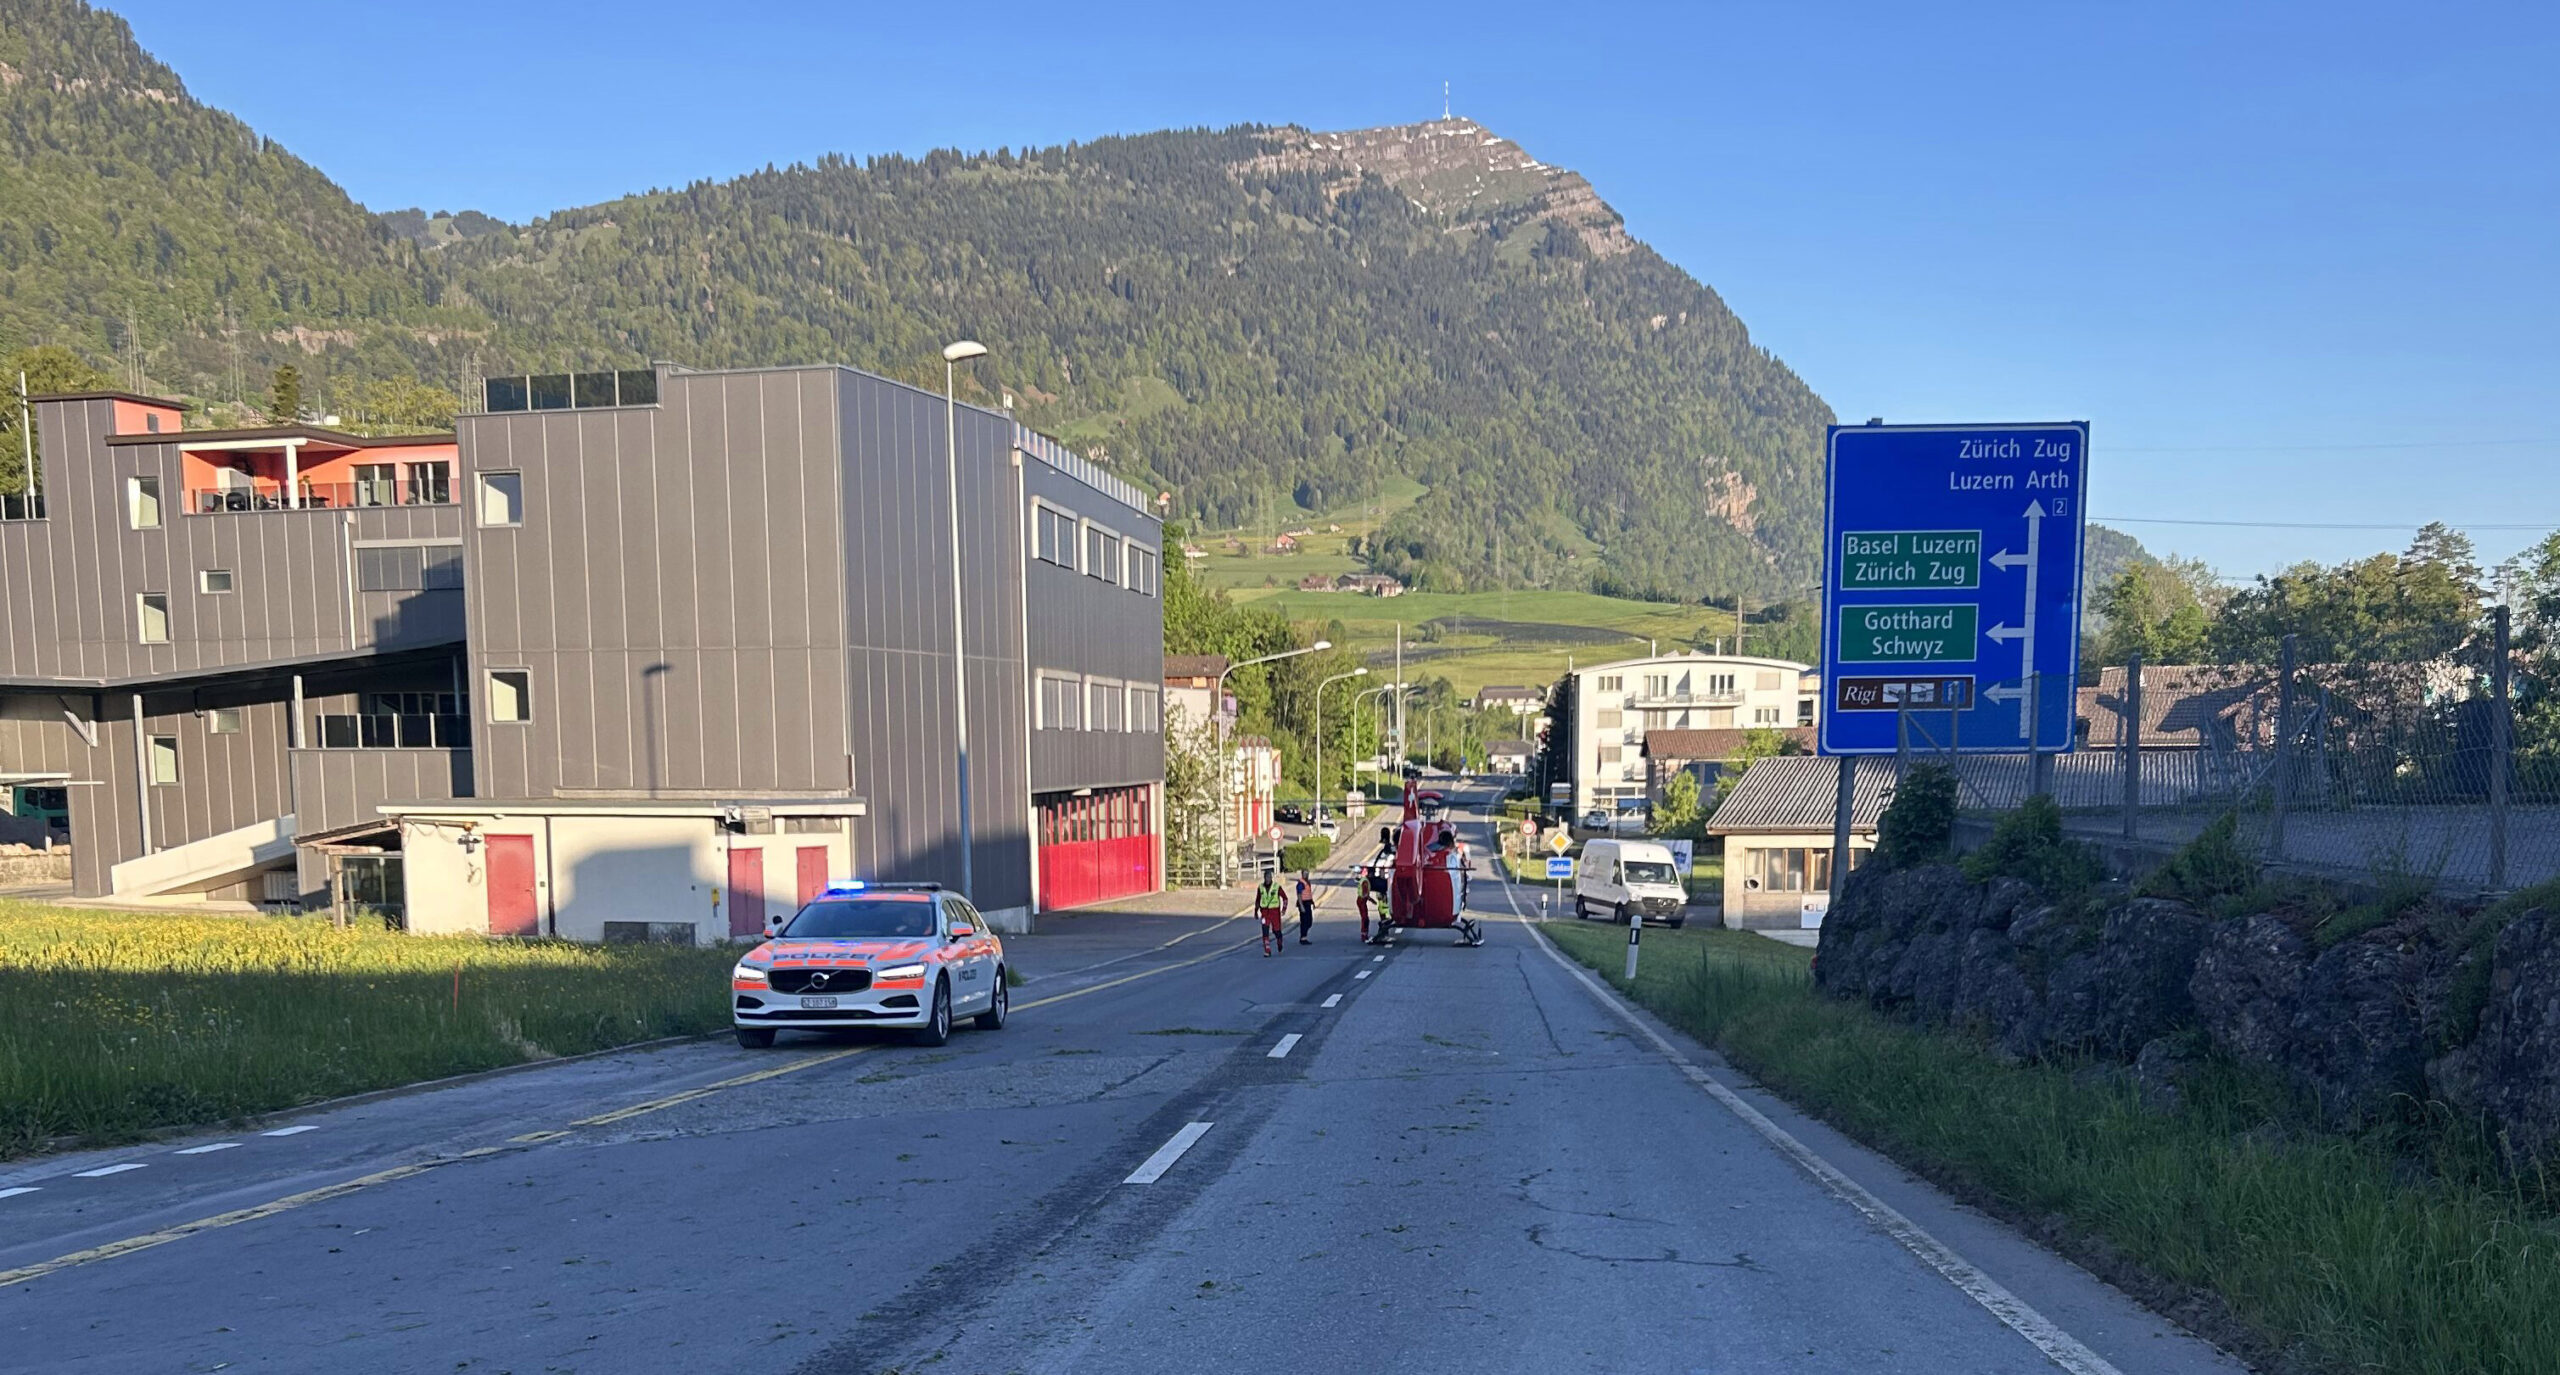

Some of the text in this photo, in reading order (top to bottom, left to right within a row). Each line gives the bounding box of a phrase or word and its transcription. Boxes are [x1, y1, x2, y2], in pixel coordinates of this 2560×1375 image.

[1959, 439, 2071, 462] Zürich Zug
[1950, 470, 2069, 490] Luzern Arth
[2055, 501, 2065, 514] 2
[1847, 536, 1976, 555] Basel Luzern
[1855, 562, 1965, 584] Zürich Zug
[1864, 611, 1953, 631] Gotthard
[1872, 636, 1944, 660] Schwyz
[1844, 687, 1878, 705] Rigi
[773, 953, 875, 961] POLIZEI
